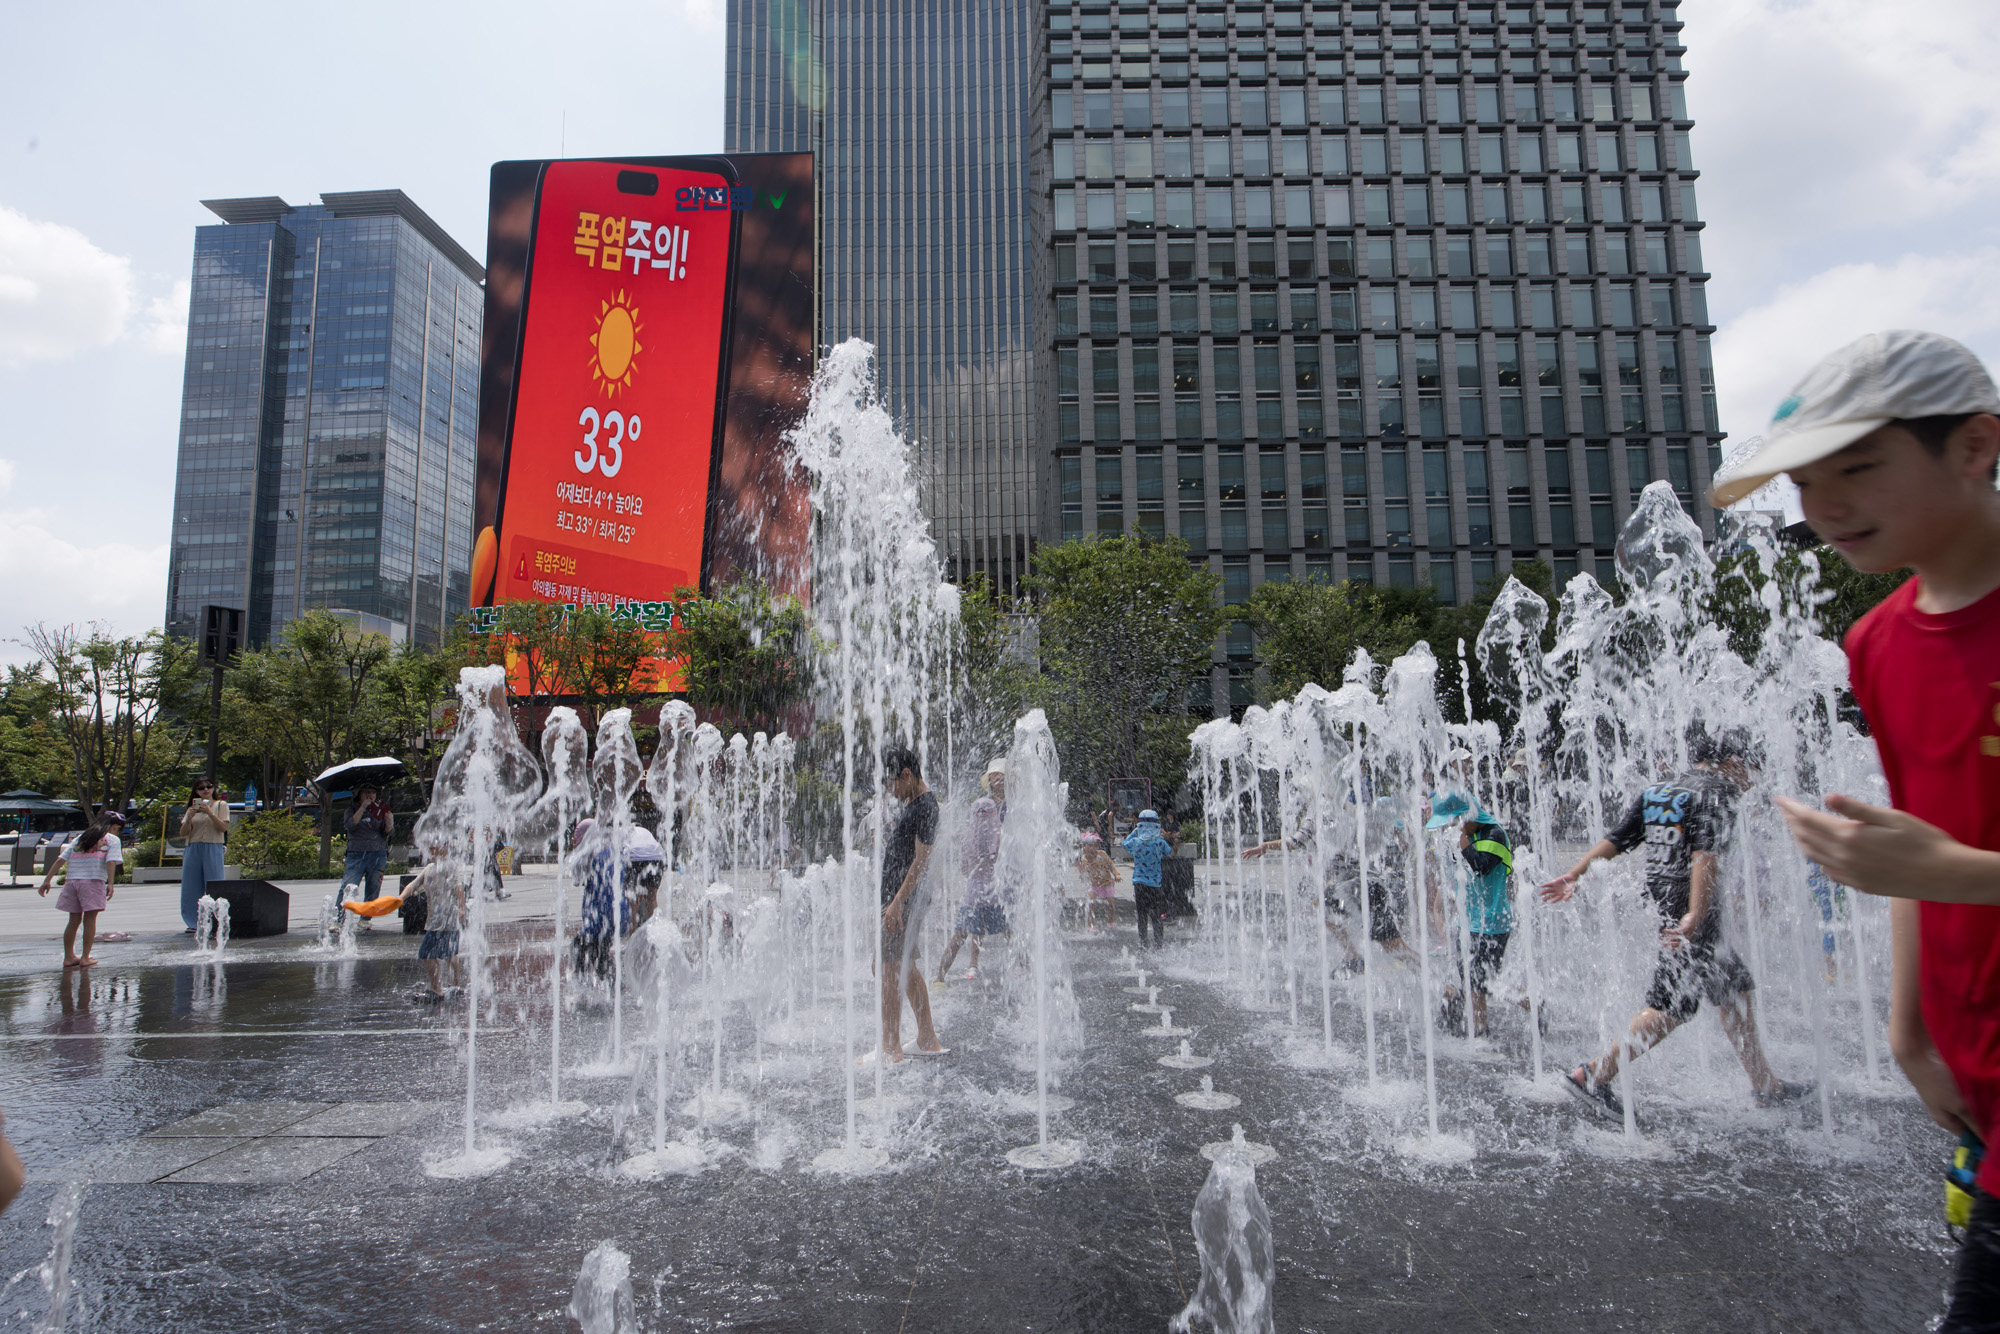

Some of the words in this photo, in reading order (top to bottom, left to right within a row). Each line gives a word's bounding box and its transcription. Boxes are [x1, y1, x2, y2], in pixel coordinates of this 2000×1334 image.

[574, 211, 689, 281] 폭염주의!
[556, 481, 593, 508] 어제보다
[616, 492, 643, 516] 높아요
[556, 511, 574, 530] 최고
[575, 515, 592, 534] 33°
[599, 520, 616, 542] 최저
[618, 524, 636, 544] 25°
[535, 551, 576, 576] 폭염주의보
[532, 579, 557, 598] 야외활동
[558, 584, 571, 601] 자제
[572, 586, 579, 602] 및
